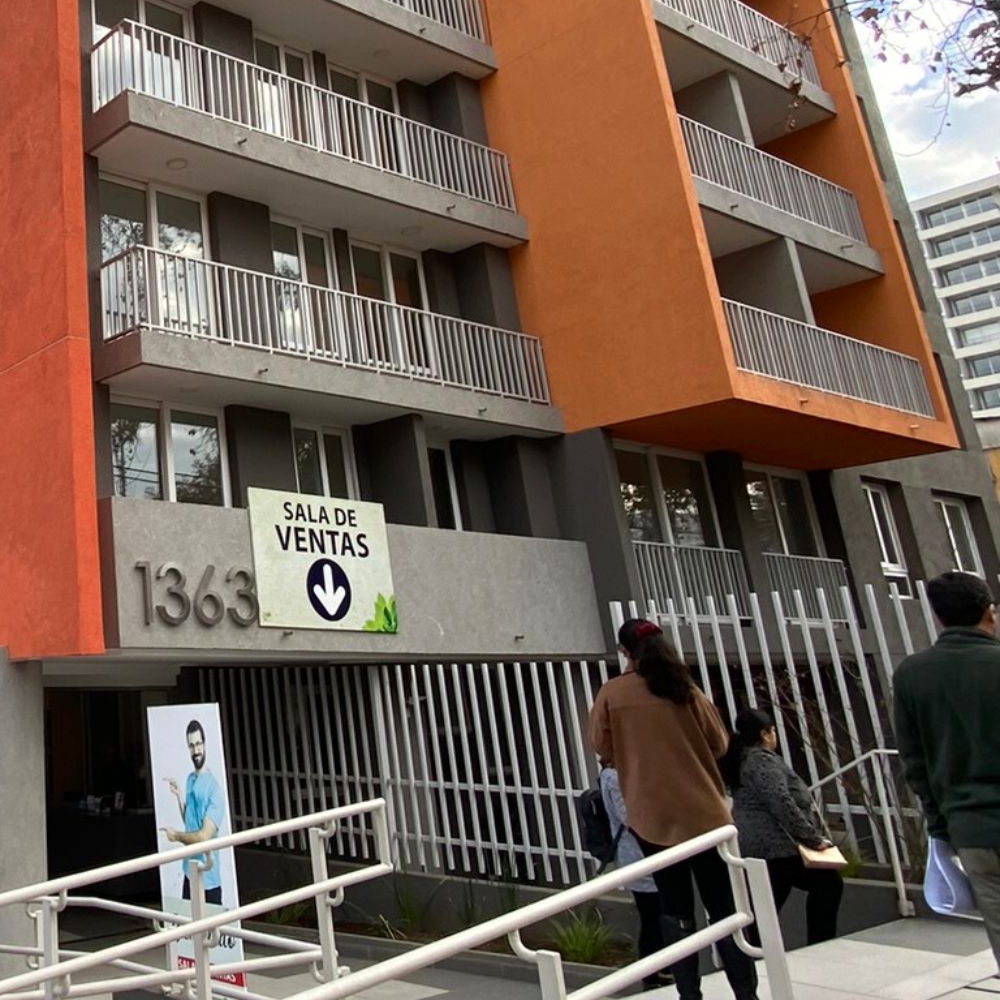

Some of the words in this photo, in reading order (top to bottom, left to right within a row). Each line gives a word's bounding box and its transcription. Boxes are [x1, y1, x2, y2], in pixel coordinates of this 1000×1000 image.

[284, 502, 329, 524] SALA
[335, 507, 358, 527] DE
[275, 525, 370, 558] VENTAS
[134, 560, 259, 628] 1363
